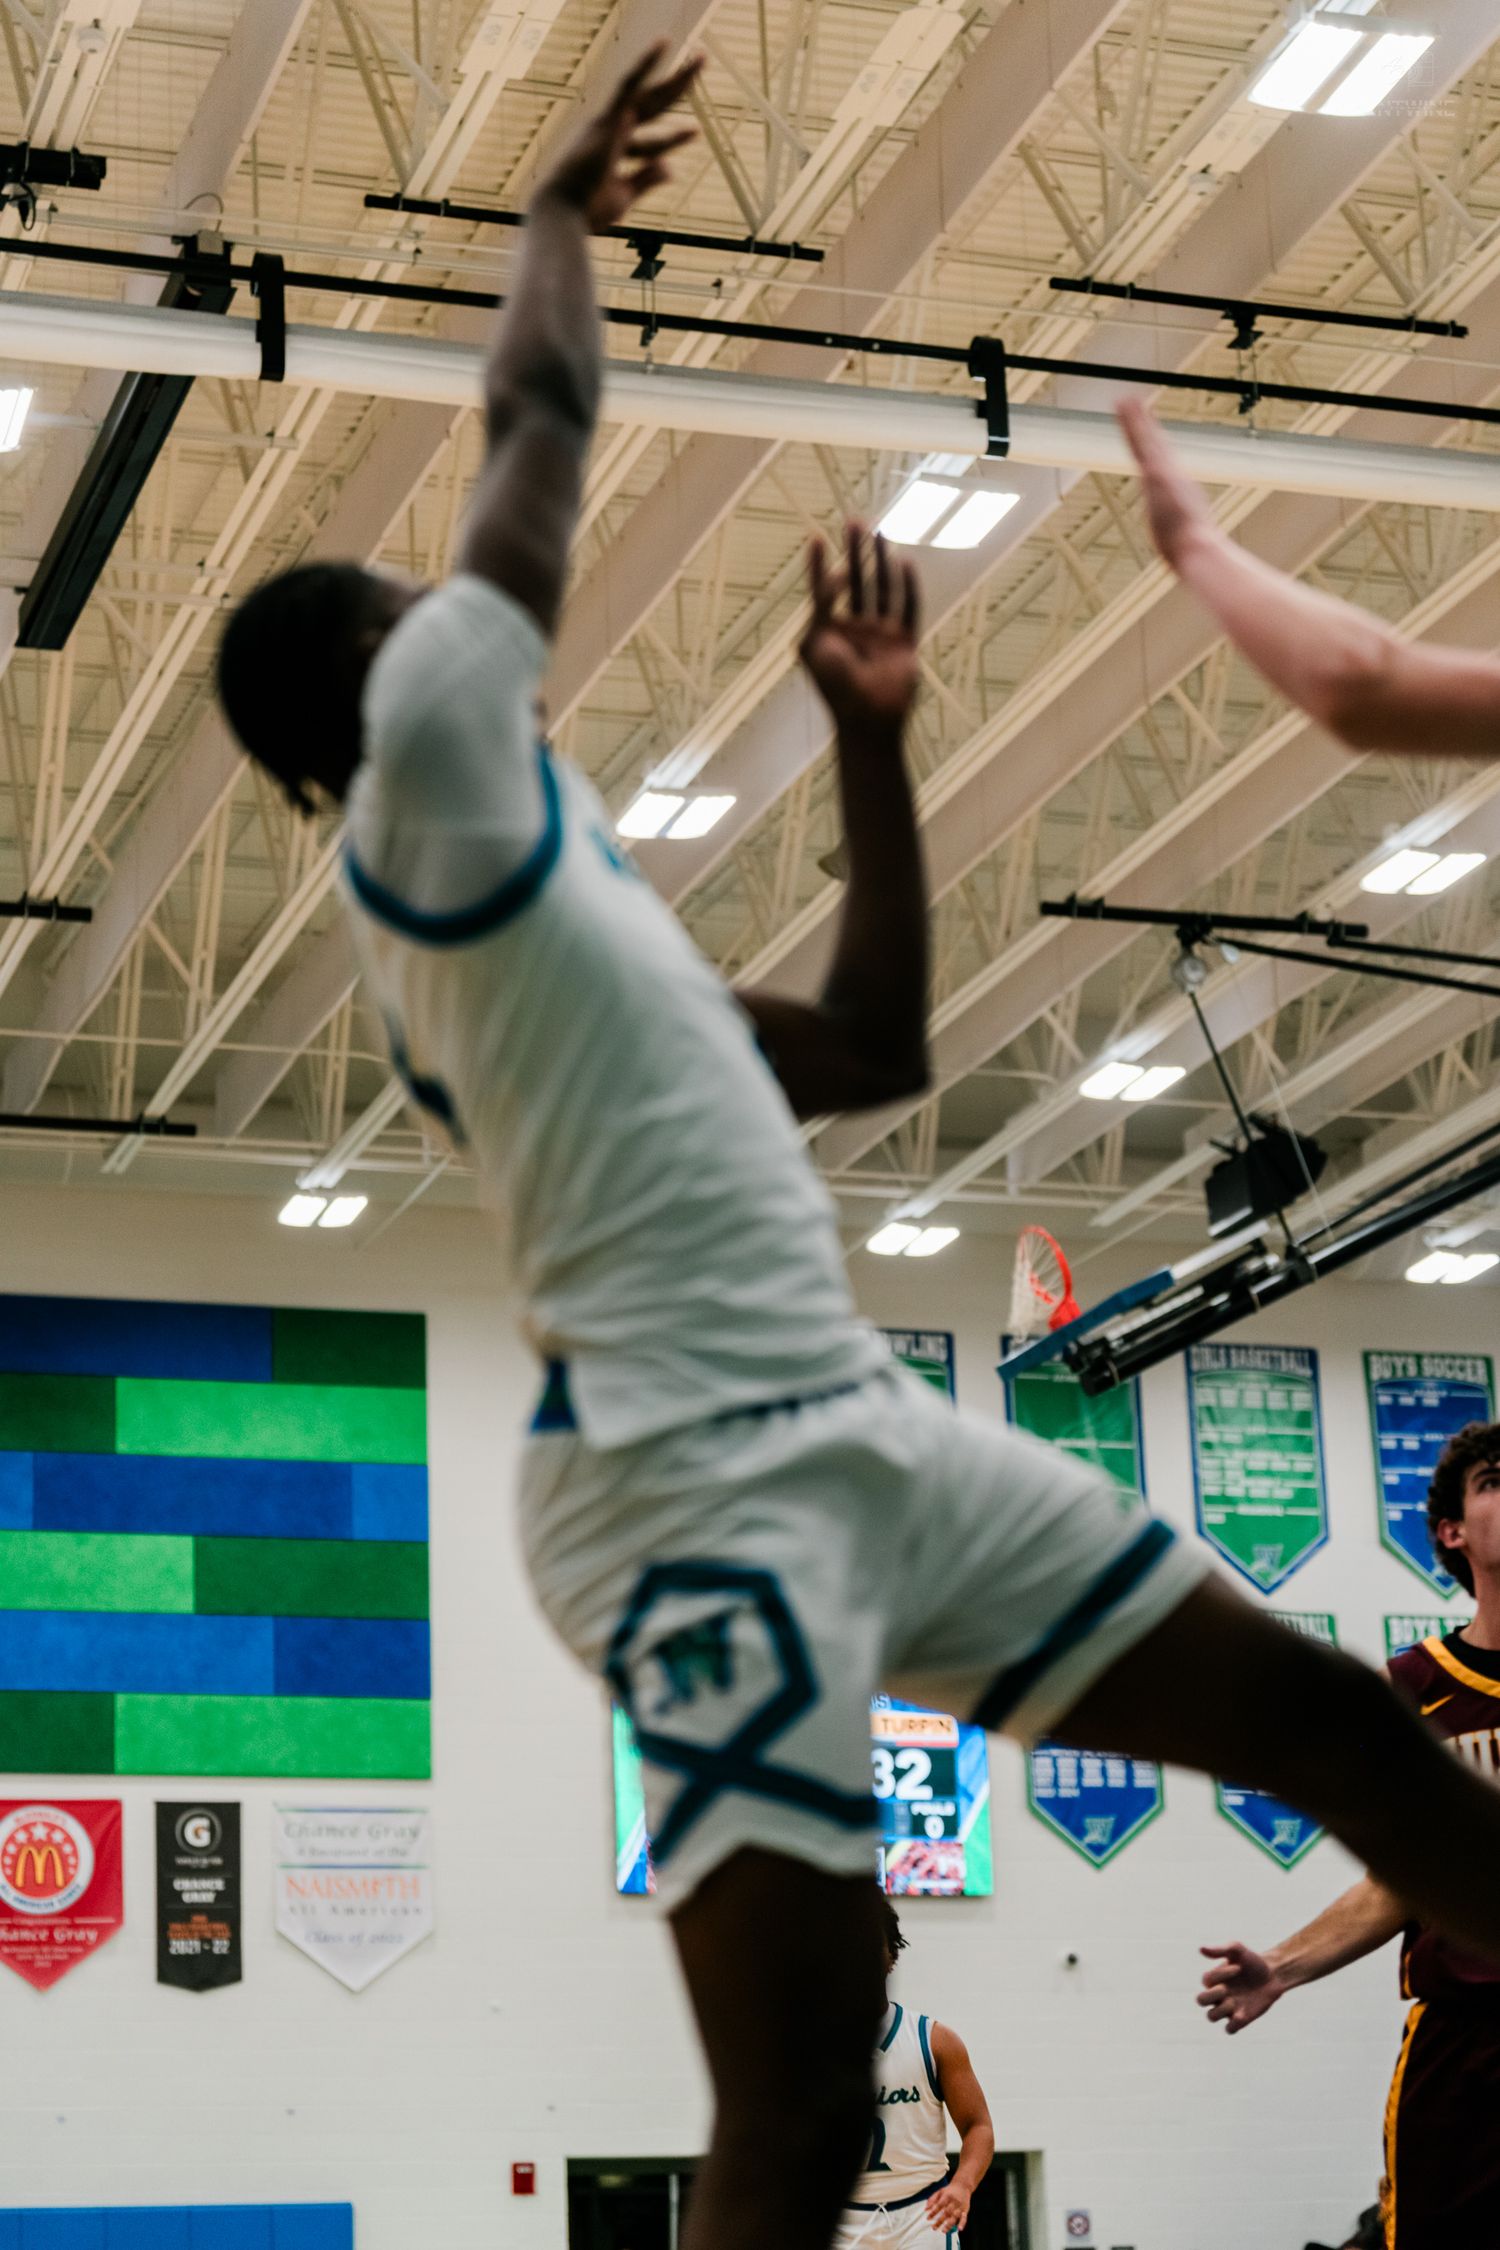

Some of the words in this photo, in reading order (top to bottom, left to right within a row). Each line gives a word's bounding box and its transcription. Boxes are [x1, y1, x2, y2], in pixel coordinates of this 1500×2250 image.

[1191, 1347, 1226, 1370] GIRLS
[1230, 1348, 1314, 1377] BASKETBALL
[1370, 1355, 1417, 1380] BOYS
[1422, 1357, 1488, 1385] SOCCER
[1389, 1617, 1440, 1645] BOYS
[881, 1717, 952, 1733] TURPIN
[870, 1747, 933, 1800] 32
[284, 1823, 360, 1839] Chance
[367, 1823, 421, 1845] Gray
[923, 1815, 945, 1840] 0
[0, 1926, 49, 1941] hance
[877, 2085, 921, 2105] iors
